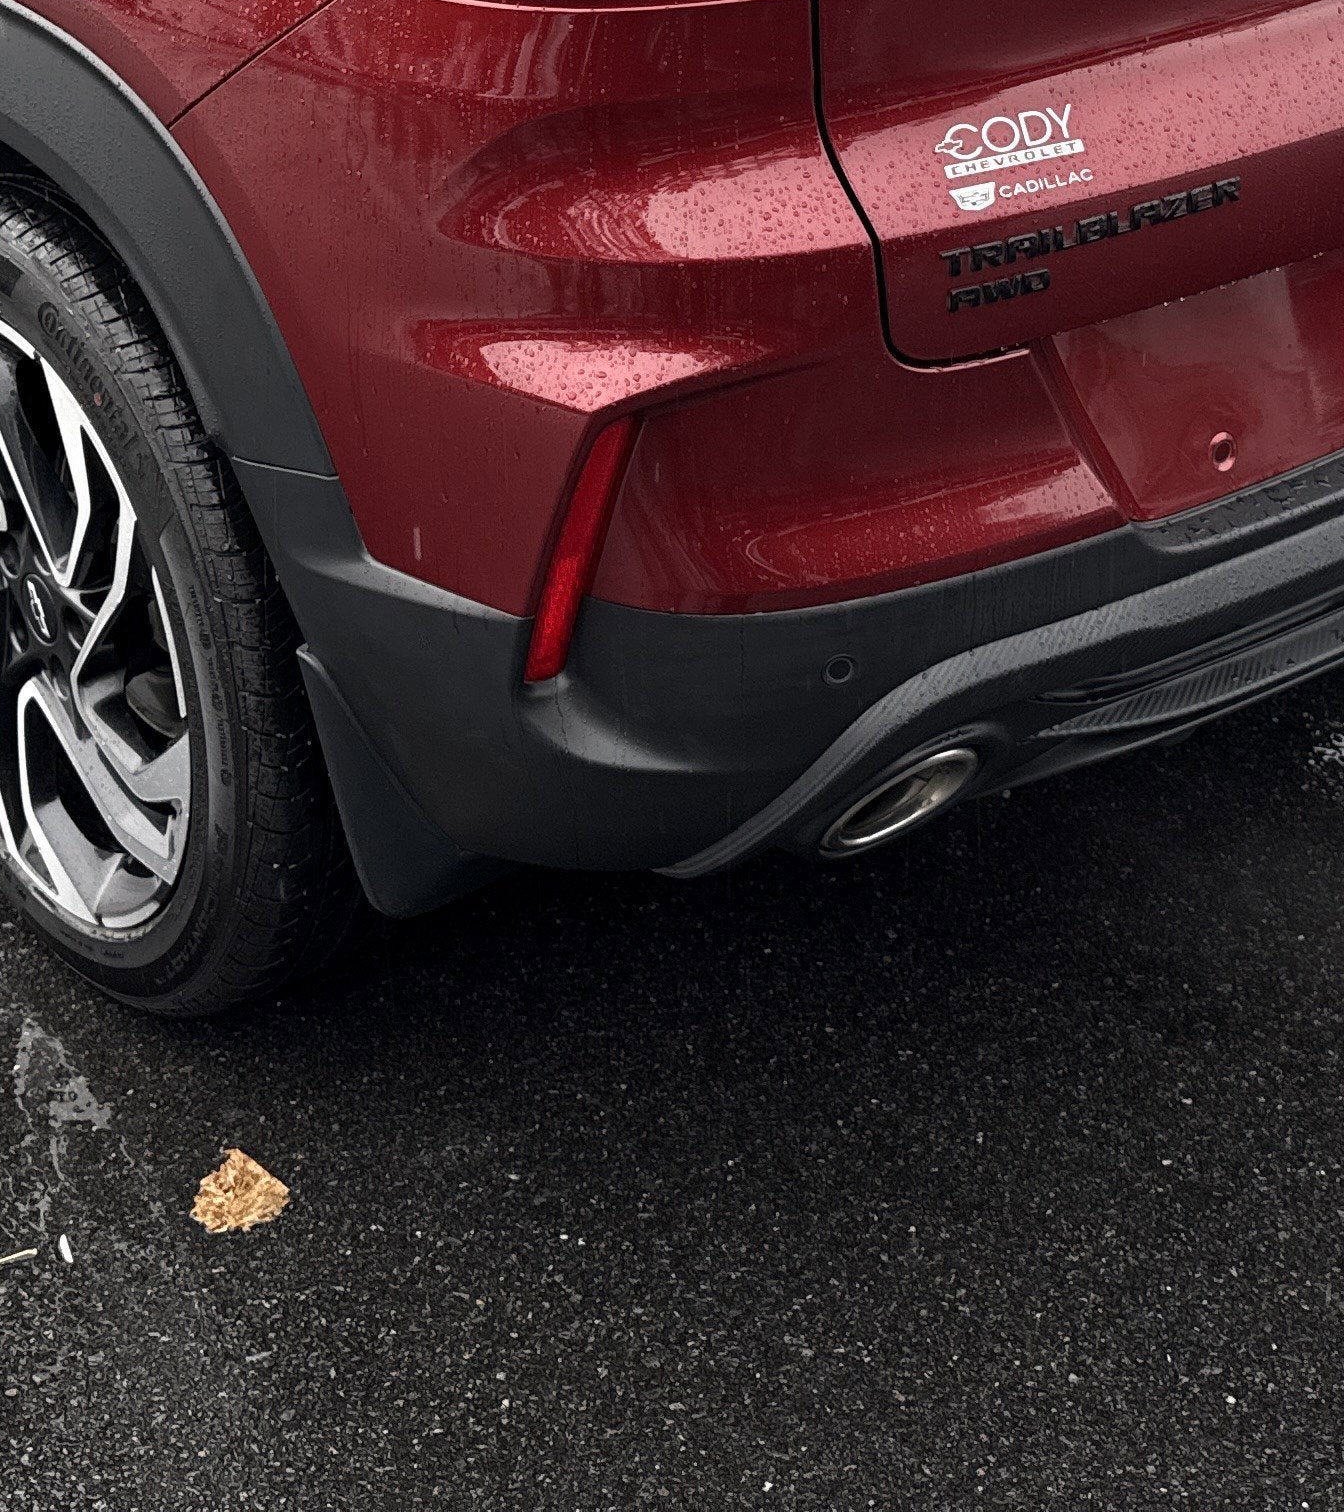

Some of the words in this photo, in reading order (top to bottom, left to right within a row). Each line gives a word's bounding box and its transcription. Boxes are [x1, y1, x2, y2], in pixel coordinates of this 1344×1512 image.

[936, 104, 1072, 160] CODY
[950, 141, 1077, 176] CHEVROLET
[998, 168, 1094, 198] CADILLAC
[939, 176, 1242, 277] TRAILBLAZER
[946, 268, 1051, 313] AWD
